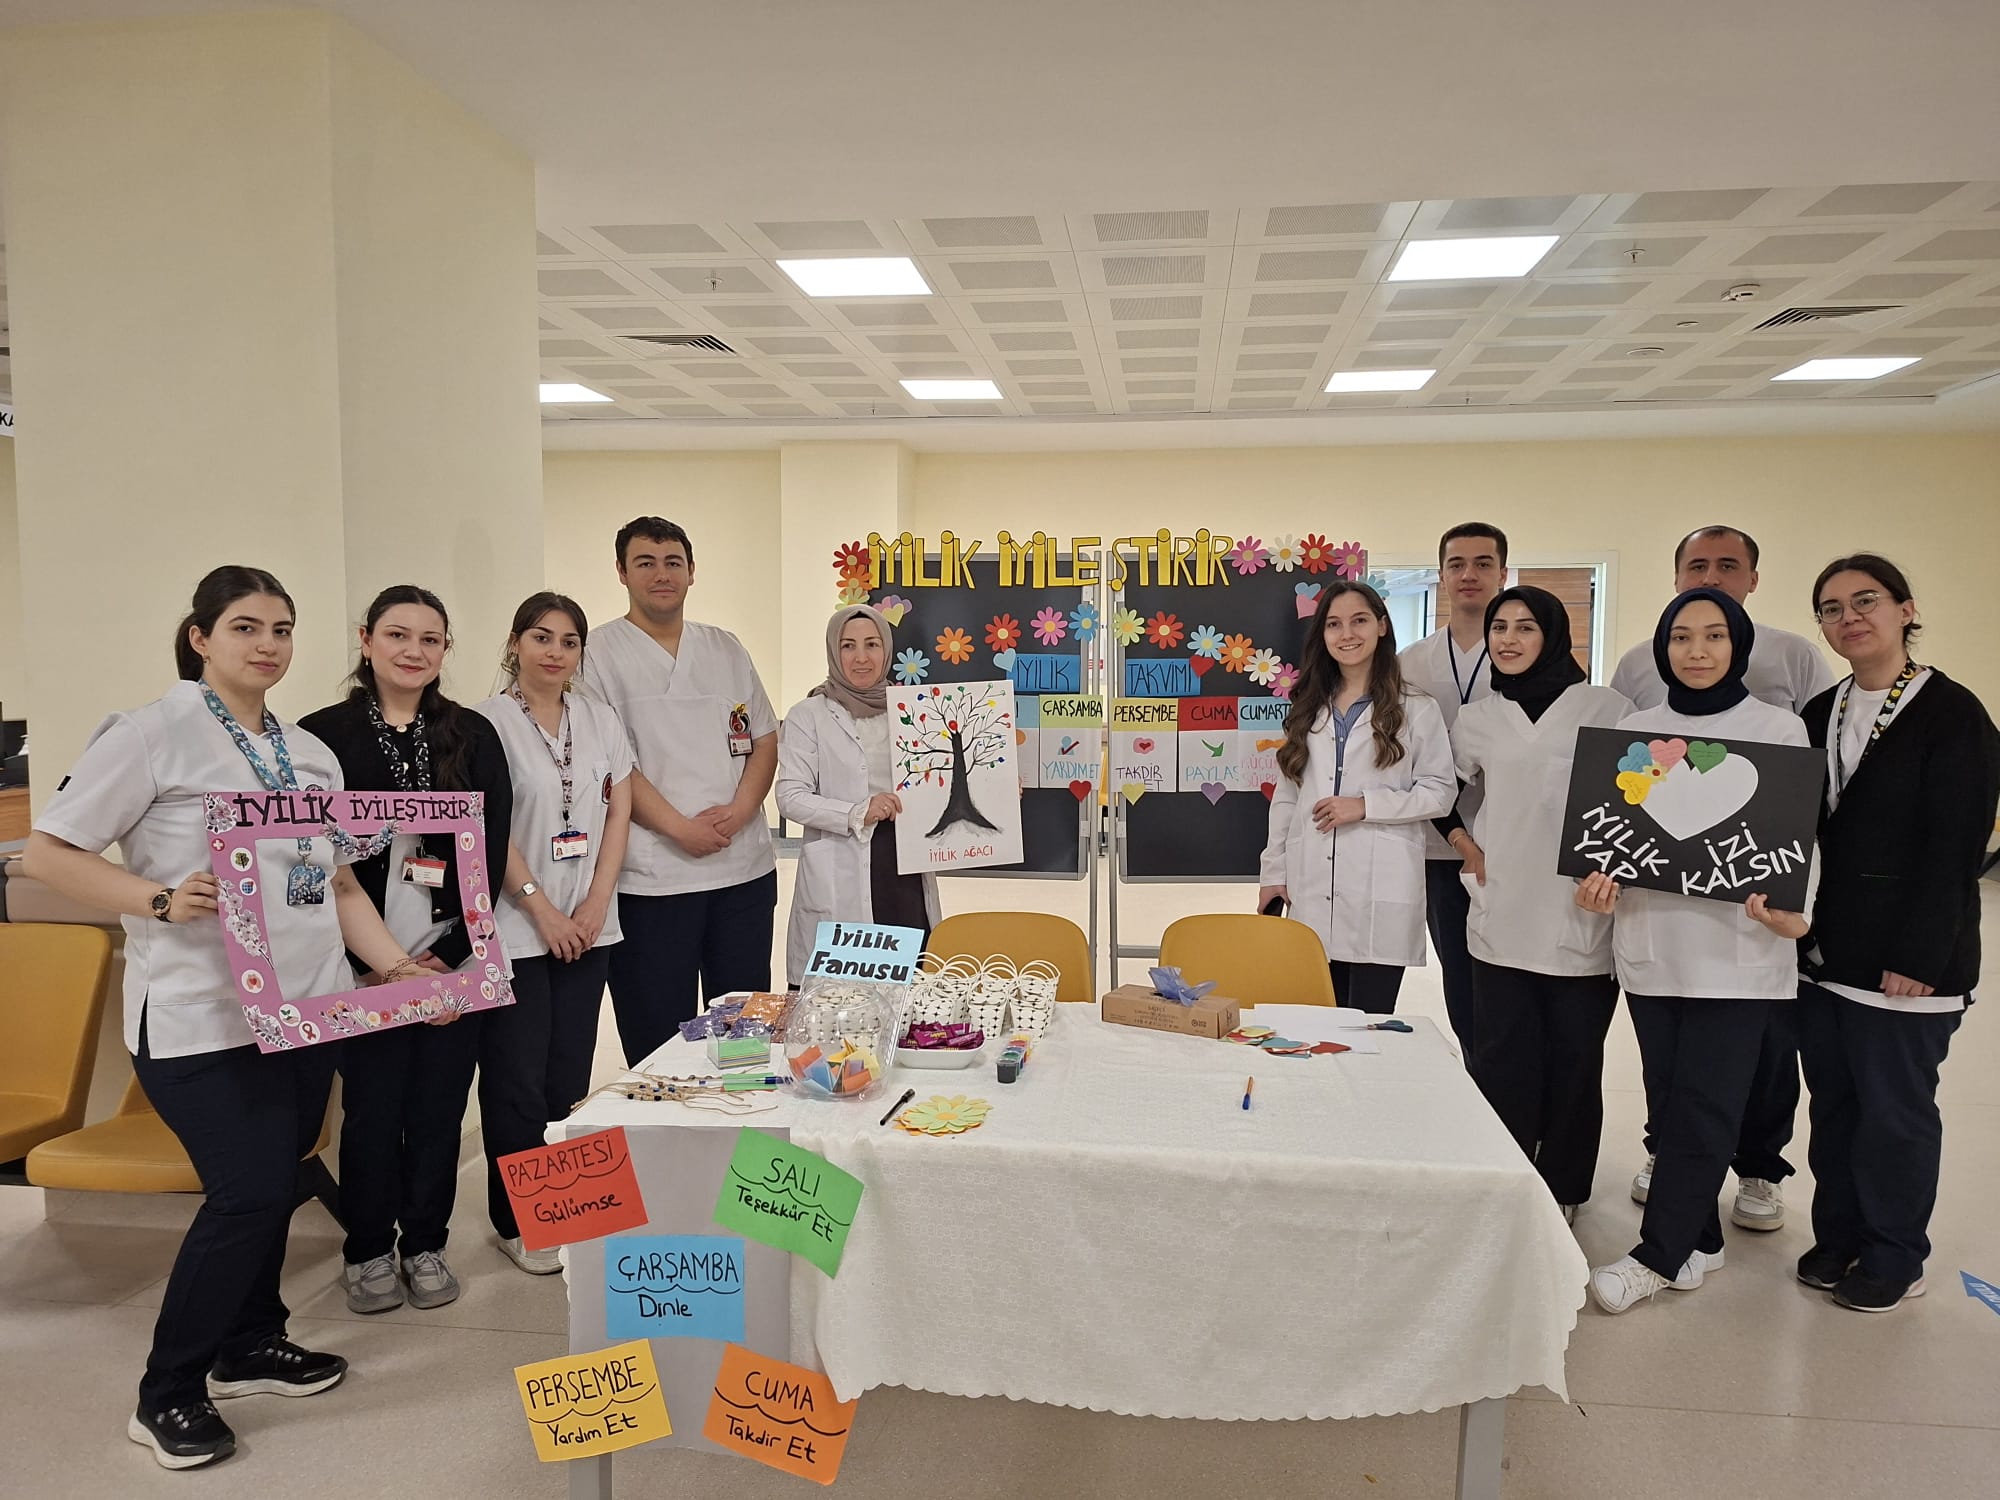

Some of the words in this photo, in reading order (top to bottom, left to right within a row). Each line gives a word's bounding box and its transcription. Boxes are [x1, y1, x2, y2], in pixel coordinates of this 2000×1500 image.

[867, 530, 983, 589] İYİLİK
[1016, 656, 1070, 691] İYİLİK
[1042, 700, 1103, 718] ÇARŞAMBA
[1114, 704, 1178, 723] PERŞEMBE
[1191, 705, 1237, 721] CUMA
[1116, 762, 1163, 780] TAKDİR
[233, 790, 337, 827] İYİLİK
[350, 792, 470, 823] İYİLEŞTİRİR
[929, 848, 957, 863] İYİLİK
[1574, 829, 1638, 880] YAP
[1582, 802, 1670, 877] İYİLİK
[1704, 821, 1758, 867] İZİ
[1681, 840, 1806, 895] KALSIN
[810, 951, 910, 982] Fanusu
[507, 1134, 614, 1188] PAZARTESİ
[763, 1157, 821, 1198] SALI
[534, 1192, 623, 1225] Gülümse
[735, 1184, 806, 1223] Teşekkür
[811, 1216, 833, 1243] Et
[617, 1251, 740, 1283] ÇARŞAMBA
[525, 1355, 644, 1410] PERŞEMBE
[744, 1370, 815, 1413] CUMA
[546, 1422, 603, 1447] Yardım
[603, 1411, 639, 1436] Et
[725, 1413, 782, 1448] Takdir
[786, 1436, 817, 1465] Et
